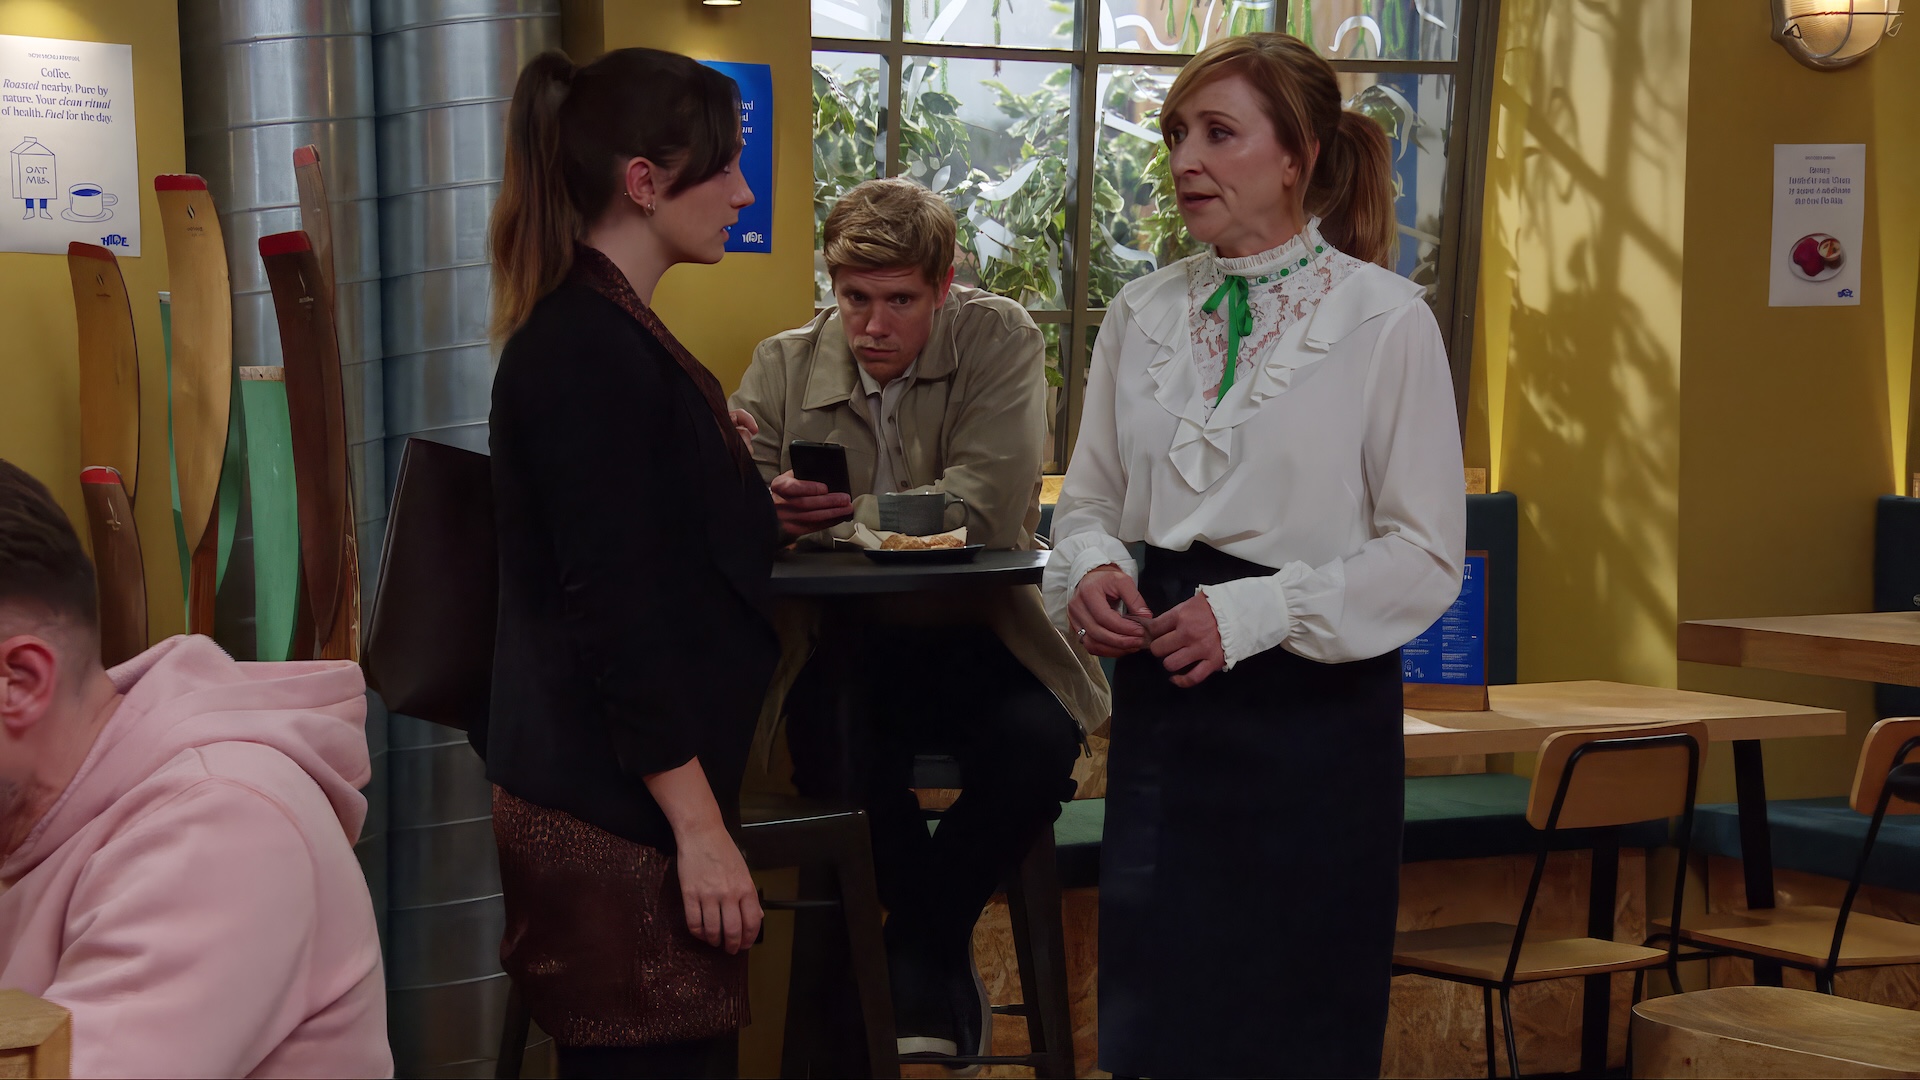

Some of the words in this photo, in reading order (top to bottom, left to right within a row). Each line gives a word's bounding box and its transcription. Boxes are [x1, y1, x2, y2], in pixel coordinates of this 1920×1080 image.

[40, 67, 71, 79] Coffee.
[3, 78, 40, 91] Roasted
[41, 82, 73, 94] nearby.
[75, 83, 96, 95] Pure
[97, 85, 109, 97] by
[2, 94, 34, 104] nature.
[36, 94, 57, 105] Your
[58, 96, 82, 107] clean
[85, 98, 112, 109] ritual
[1, 106, 11, 116] of
[13, 106, 44, 118] health.
[45, 108, 65, 119] Fuel
[66, 109, 79, 120] for
[80, 110, 95, 122] the
[96, 112, 113, 124] day.
[25, 166, 48, 175] OAT
